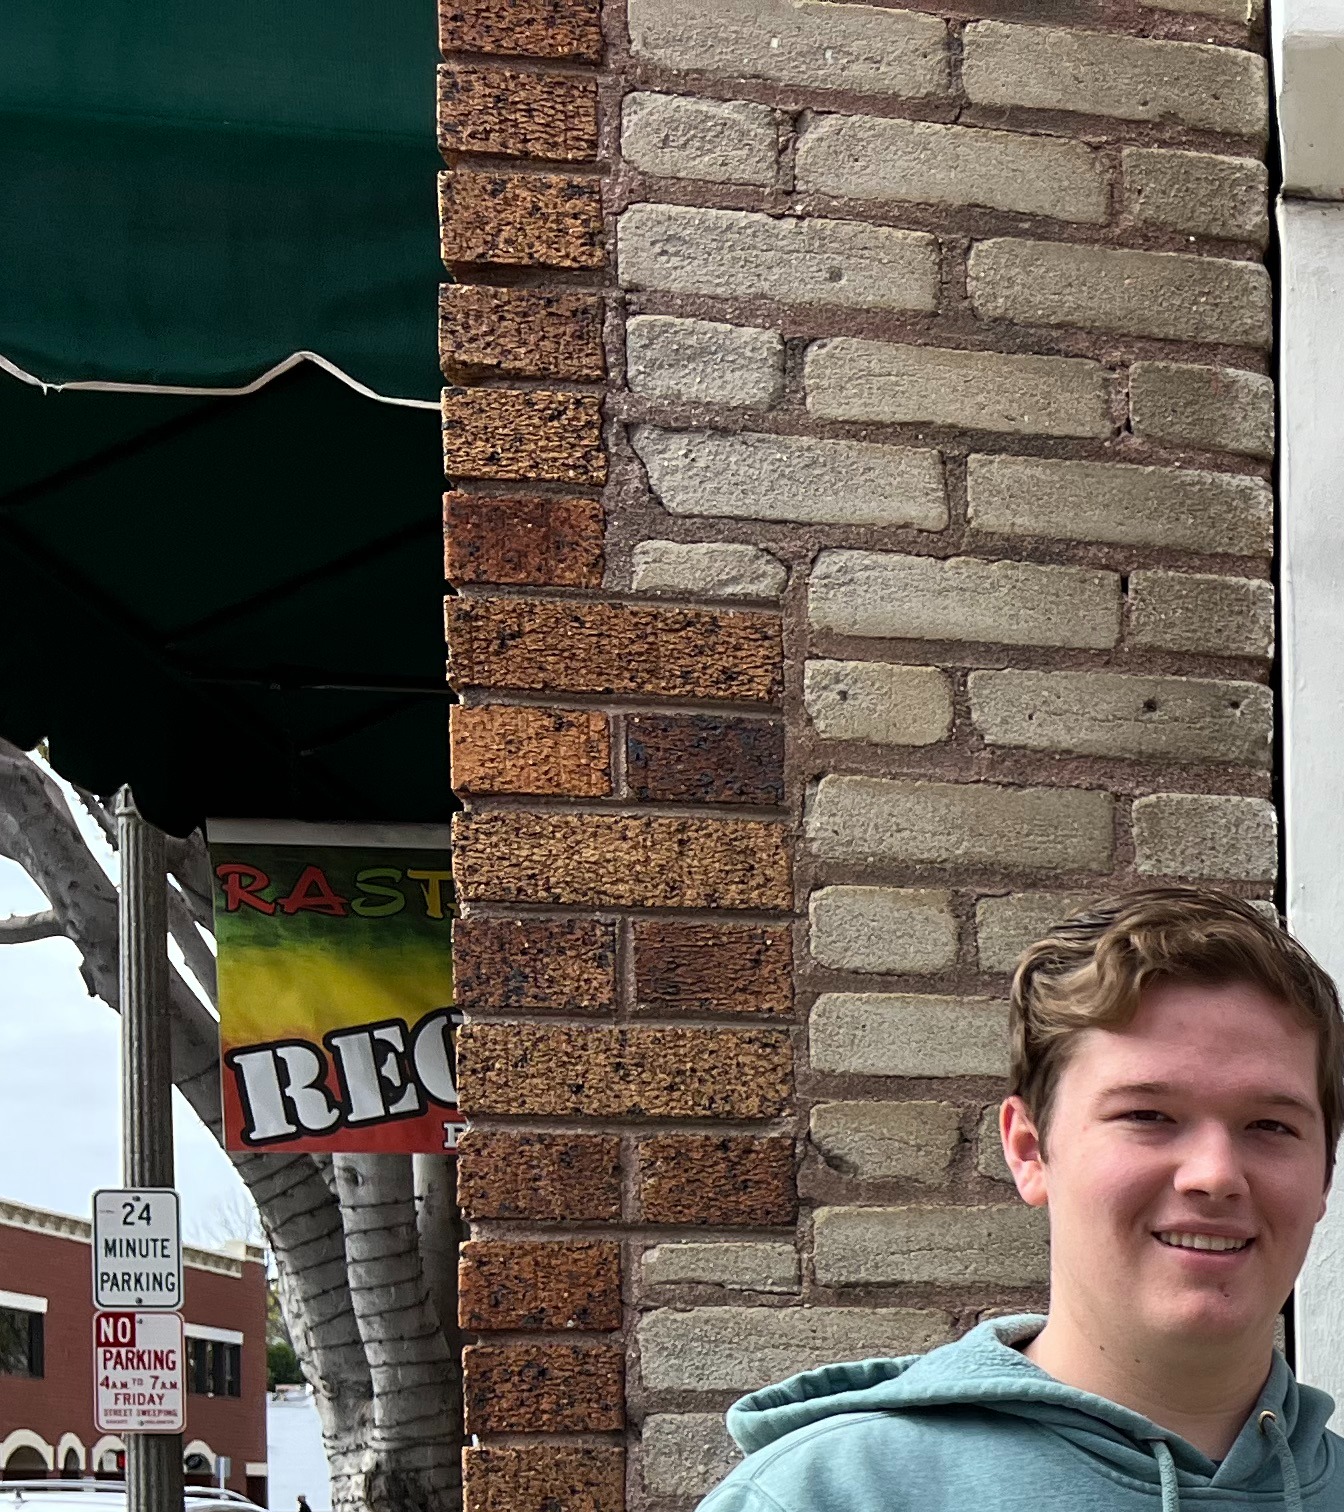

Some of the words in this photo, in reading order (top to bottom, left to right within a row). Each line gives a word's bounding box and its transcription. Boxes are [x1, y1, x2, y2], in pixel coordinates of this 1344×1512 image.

[216, 863, 460, 919] RAST
[121, 1202, 152, 1226] 24
[103, 1238, 171, 1259] MINUTE
[100, 1271, 176, 1293] PARKING
[99, 1316, 132, 1343] NO
[103, 1349, 177, 1371] PARKING
[114, 1392, 165, 1406] FRIDAY
